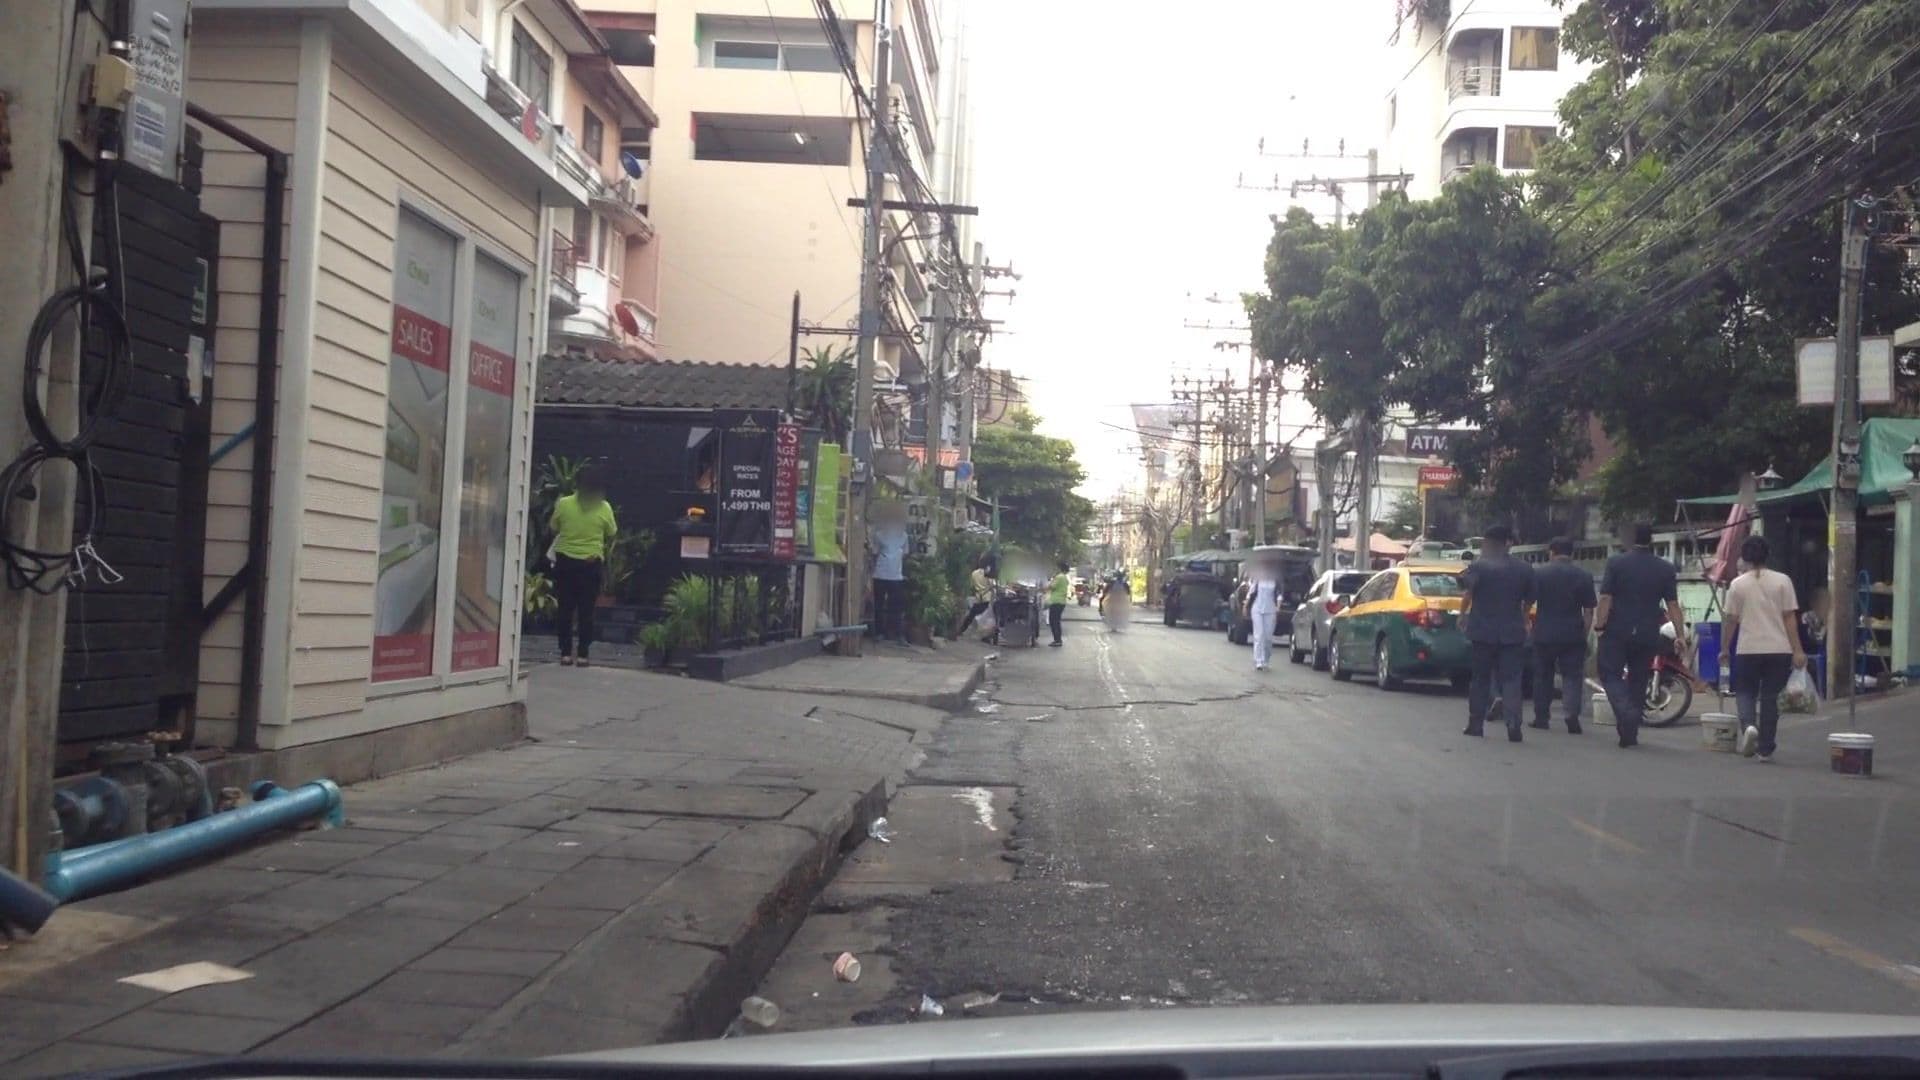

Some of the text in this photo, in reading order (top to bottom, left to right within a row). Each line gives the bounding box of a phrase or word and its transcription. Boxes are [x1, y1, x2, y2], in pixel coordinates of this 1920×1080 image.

[398, 319, 434, 355] SALES
[471, 351, 503, 385] OFFICE
[1411, 435, 1449, 450] ATM
[730, 488, 761, 498] FROM
[721, 501, 748, 511] 1,499
[751, 501, 771, 511] THB
